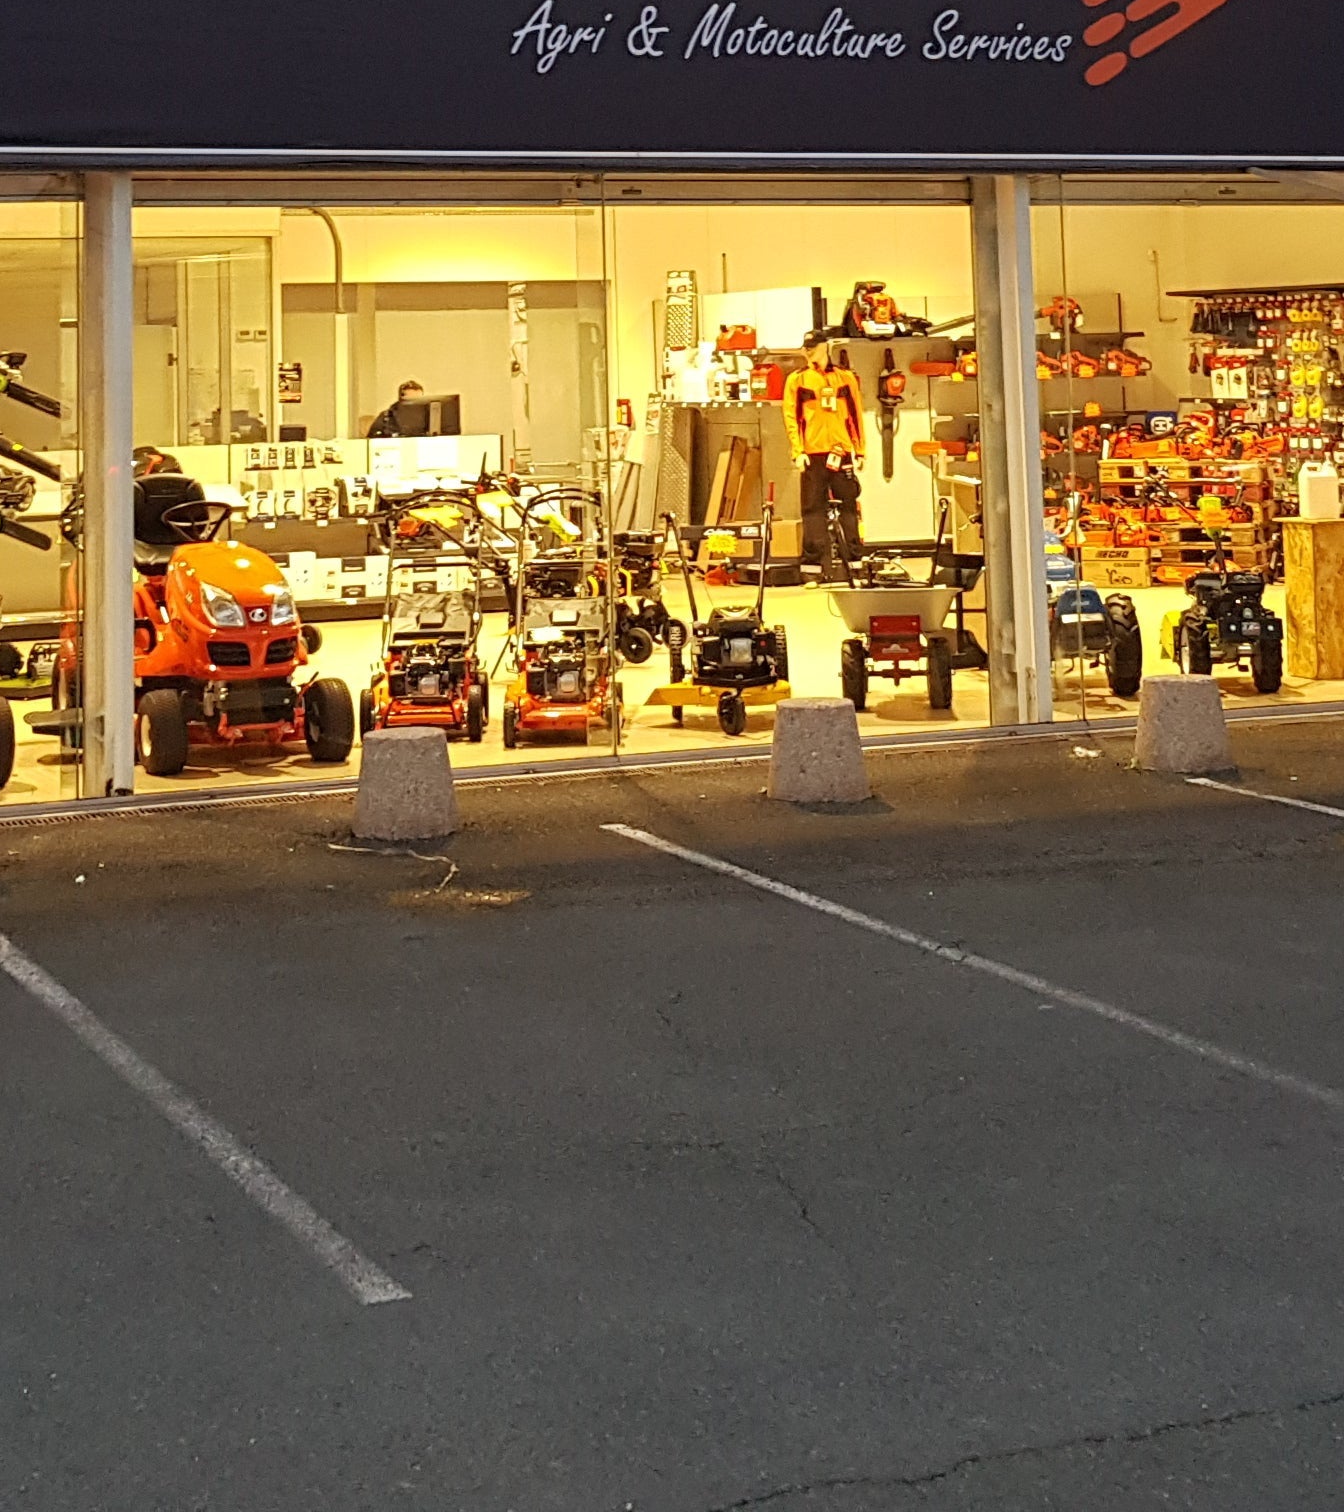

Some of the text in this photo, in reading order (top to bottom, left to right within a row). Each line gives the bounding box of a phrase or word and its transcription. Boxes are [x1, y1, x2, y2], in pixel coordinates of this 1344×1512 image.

[511, 0, 1072, 73] Agri & Motoculture Services
